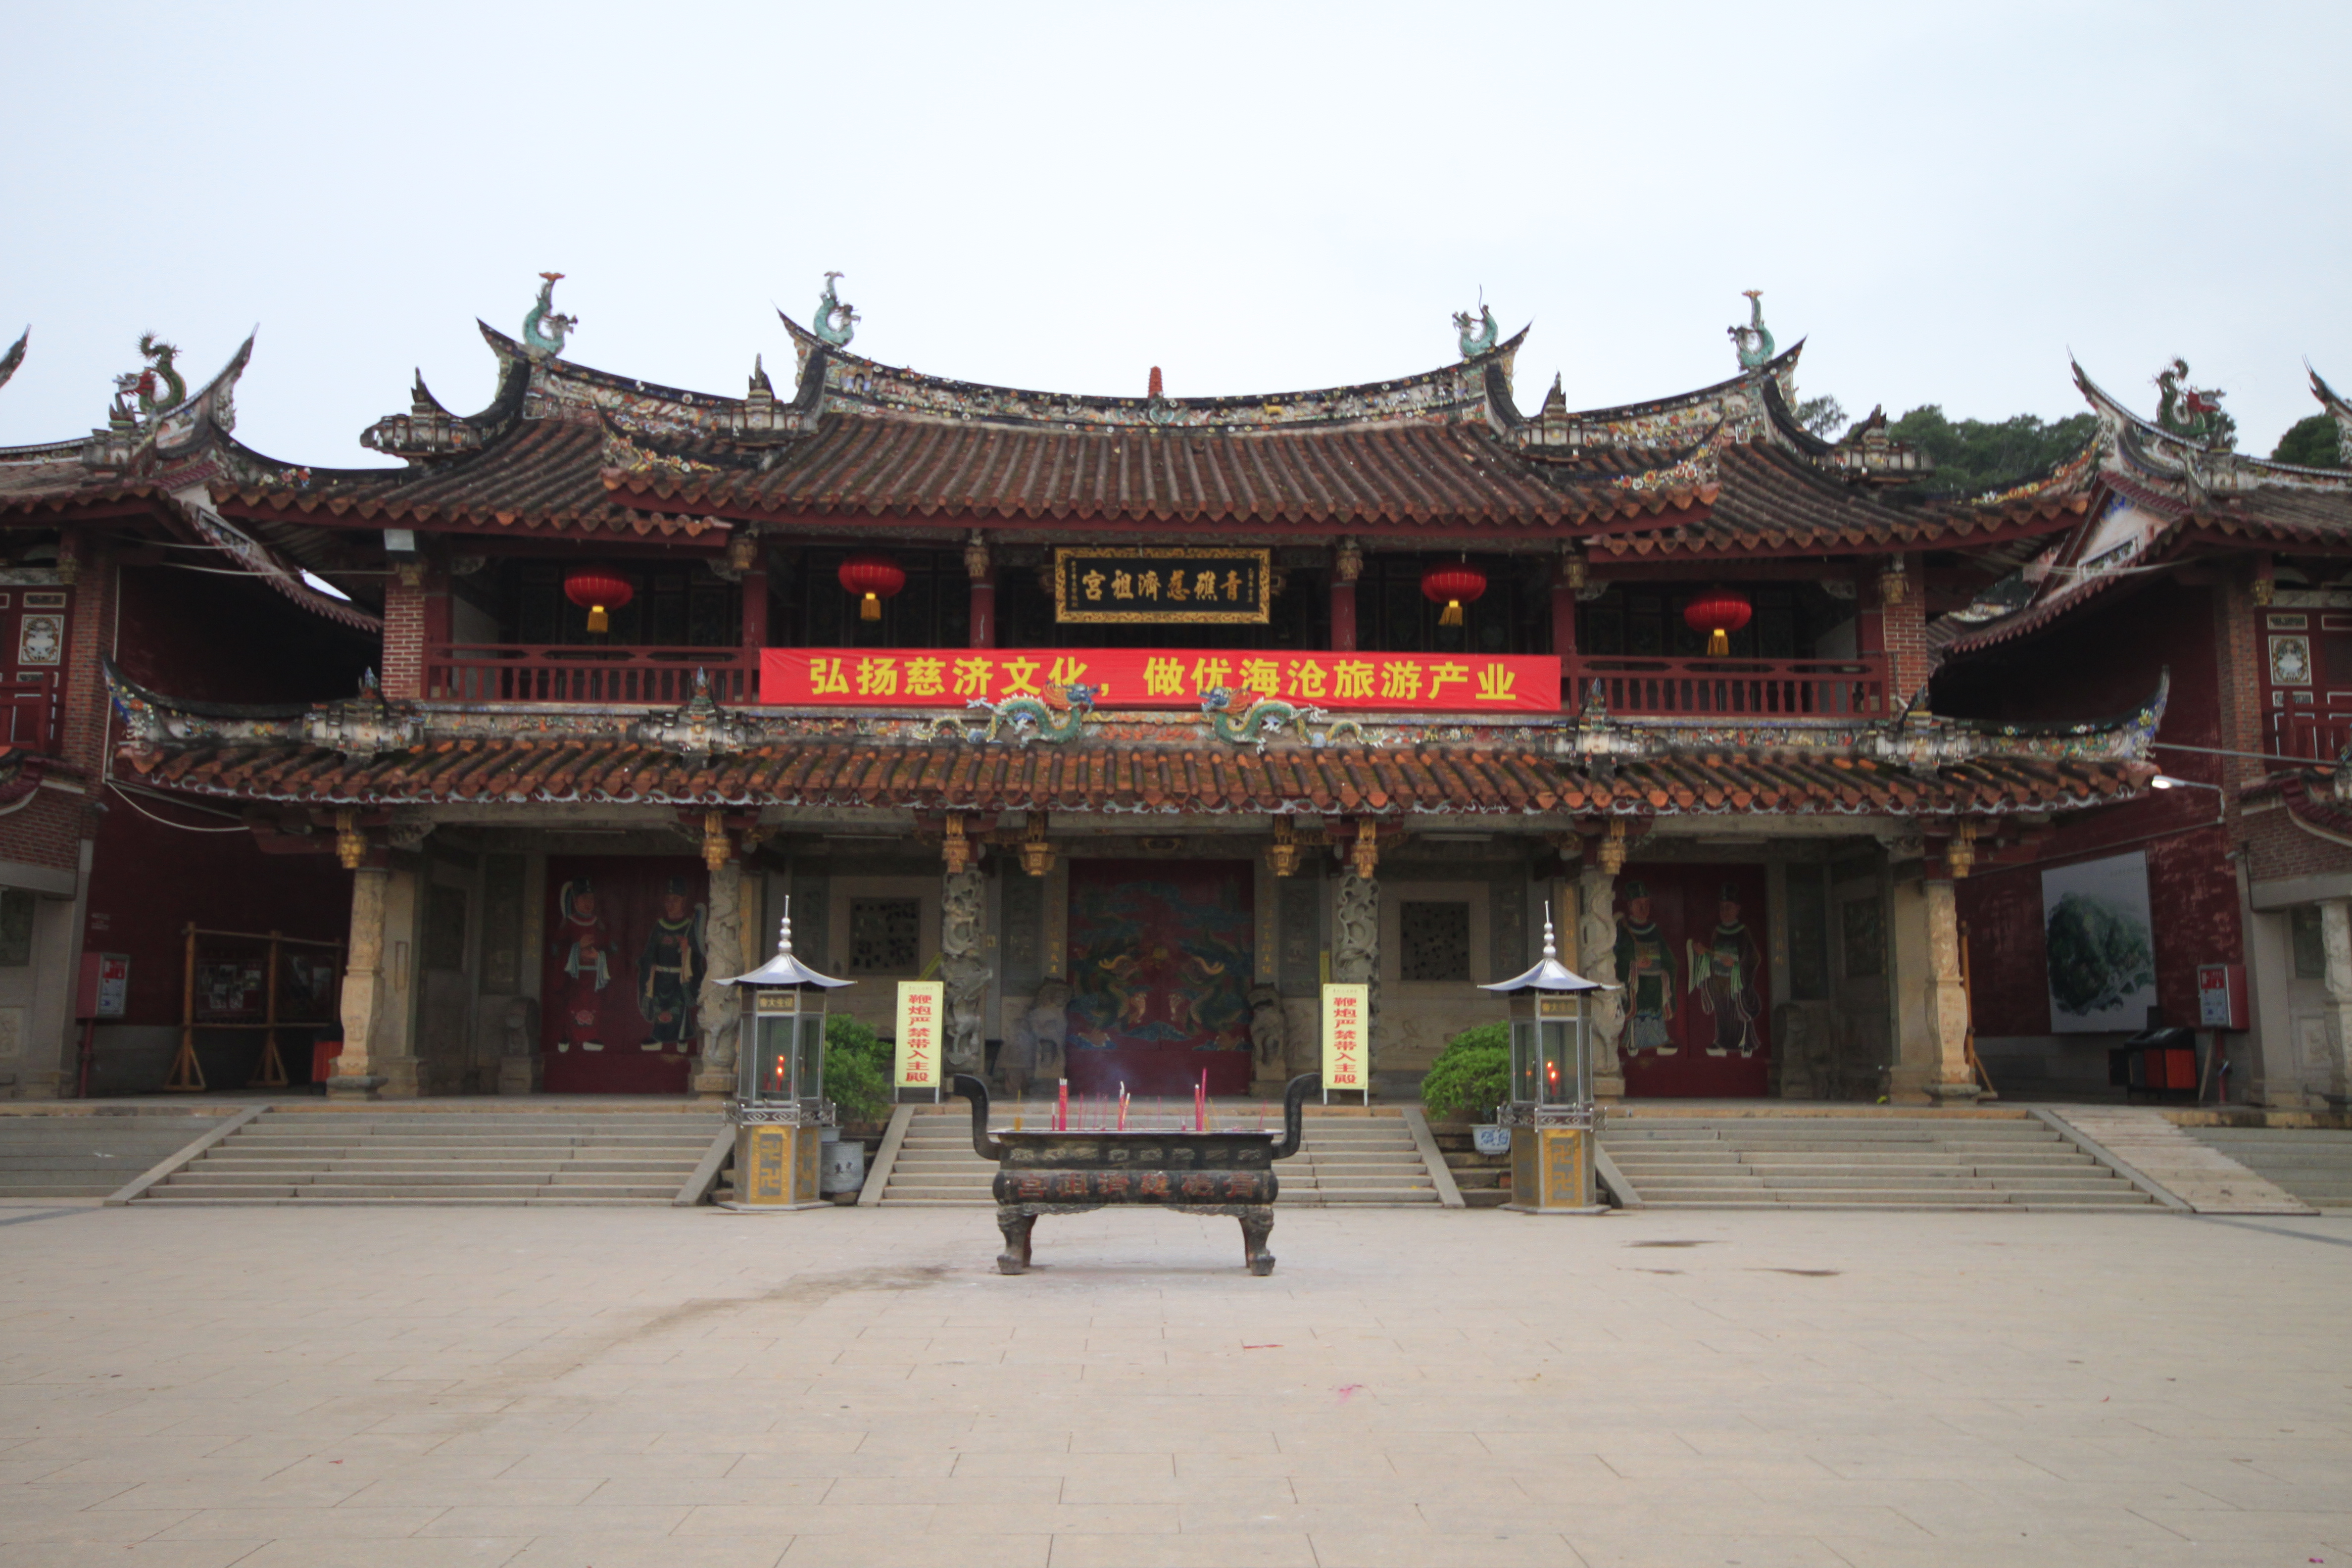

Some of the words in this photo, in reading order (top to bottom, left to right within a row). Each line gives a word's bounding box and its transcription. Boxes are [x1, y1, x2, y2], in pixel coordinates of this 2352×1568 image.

[905, 994, 932, 1082] 鞭炮严禁带入主殿
[1333, 997, 1357, 1084] 鞭炮严禁带入主殿
